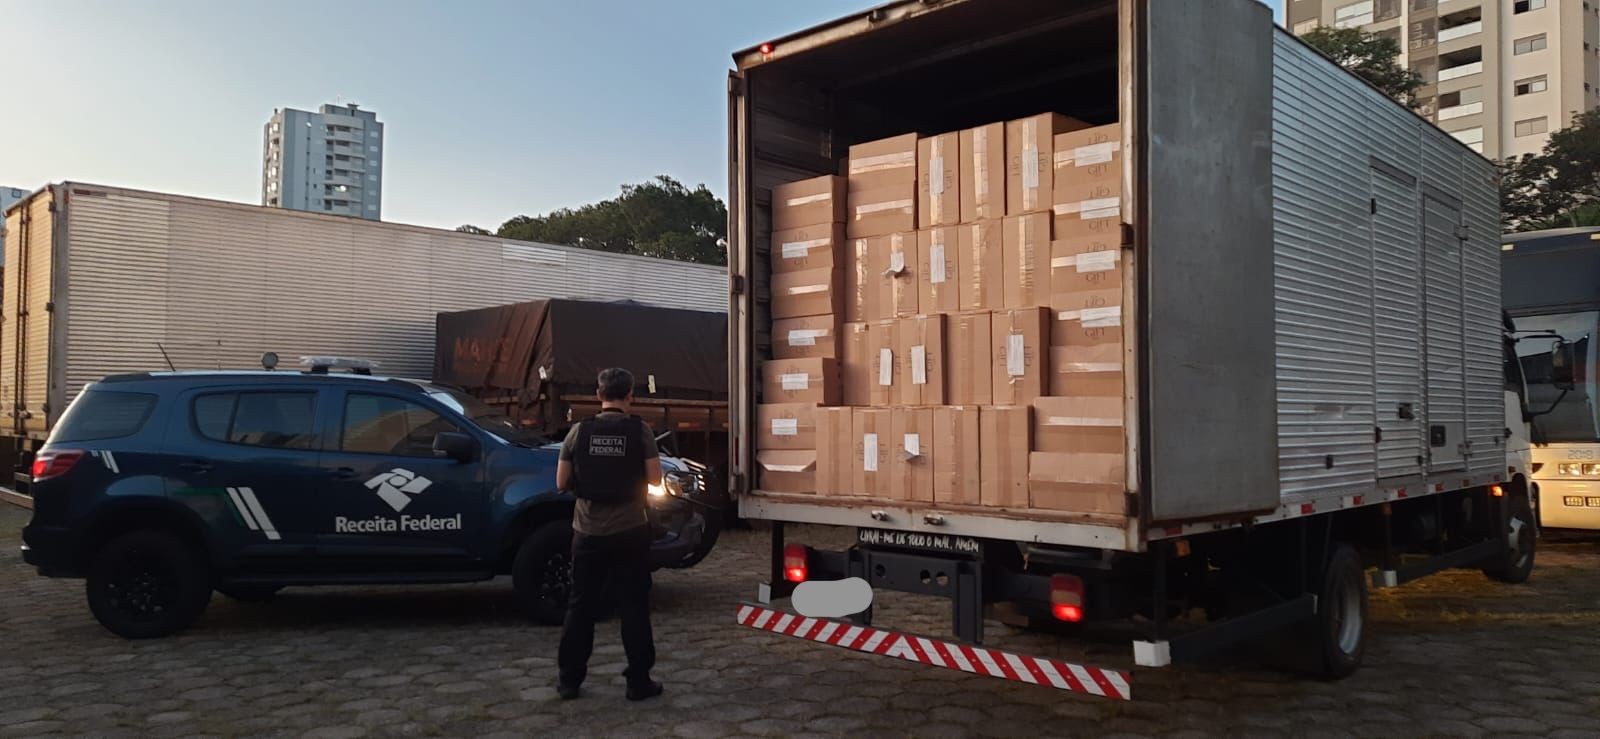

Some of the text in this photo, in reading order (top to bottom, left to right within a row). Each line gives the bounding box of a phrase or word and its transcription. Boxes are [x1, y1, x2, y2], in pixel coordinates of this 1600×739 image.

[592, 438, 624, 446] RECEITA
[592, 446, 623, 454] FEDERAL
[336, 513, 462, 532] Receita Federal
[926, 535, 932, 547] O
